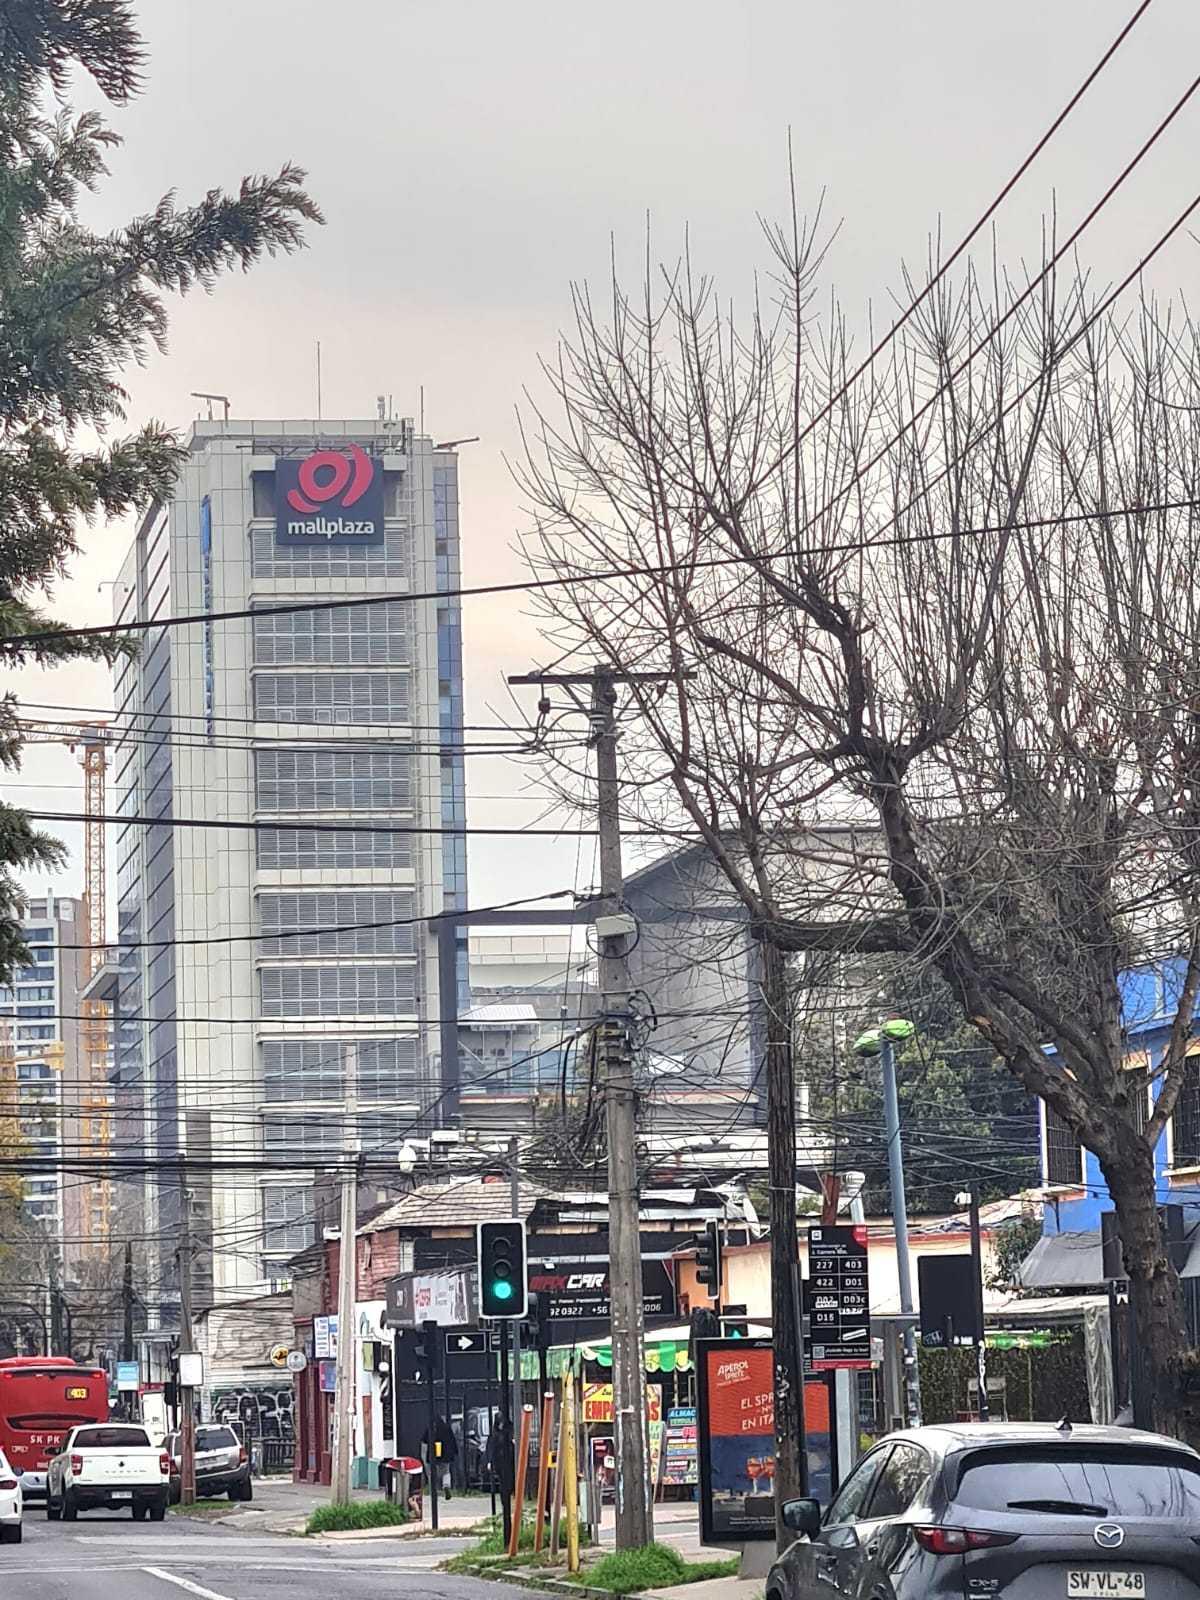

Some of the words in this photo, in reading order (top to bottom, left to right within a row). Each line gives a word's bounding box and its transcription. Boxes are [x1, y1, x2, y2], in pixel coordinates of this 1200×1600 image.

[287, 517, 375, 540] mallplaza
[816, 1261, 833, 1269] 227
[844, 1261, 862, 1269] 403
[815, 1278, 834, 1287] 422
[845, 1278, 862, 1287] D01
[717, 1360, 749, 1376] APEROL
[740, 1397, 753, 1410] EL
[742, 1417, 757, 1431] EN
[969, 1579, 999, 1588] CX-5
